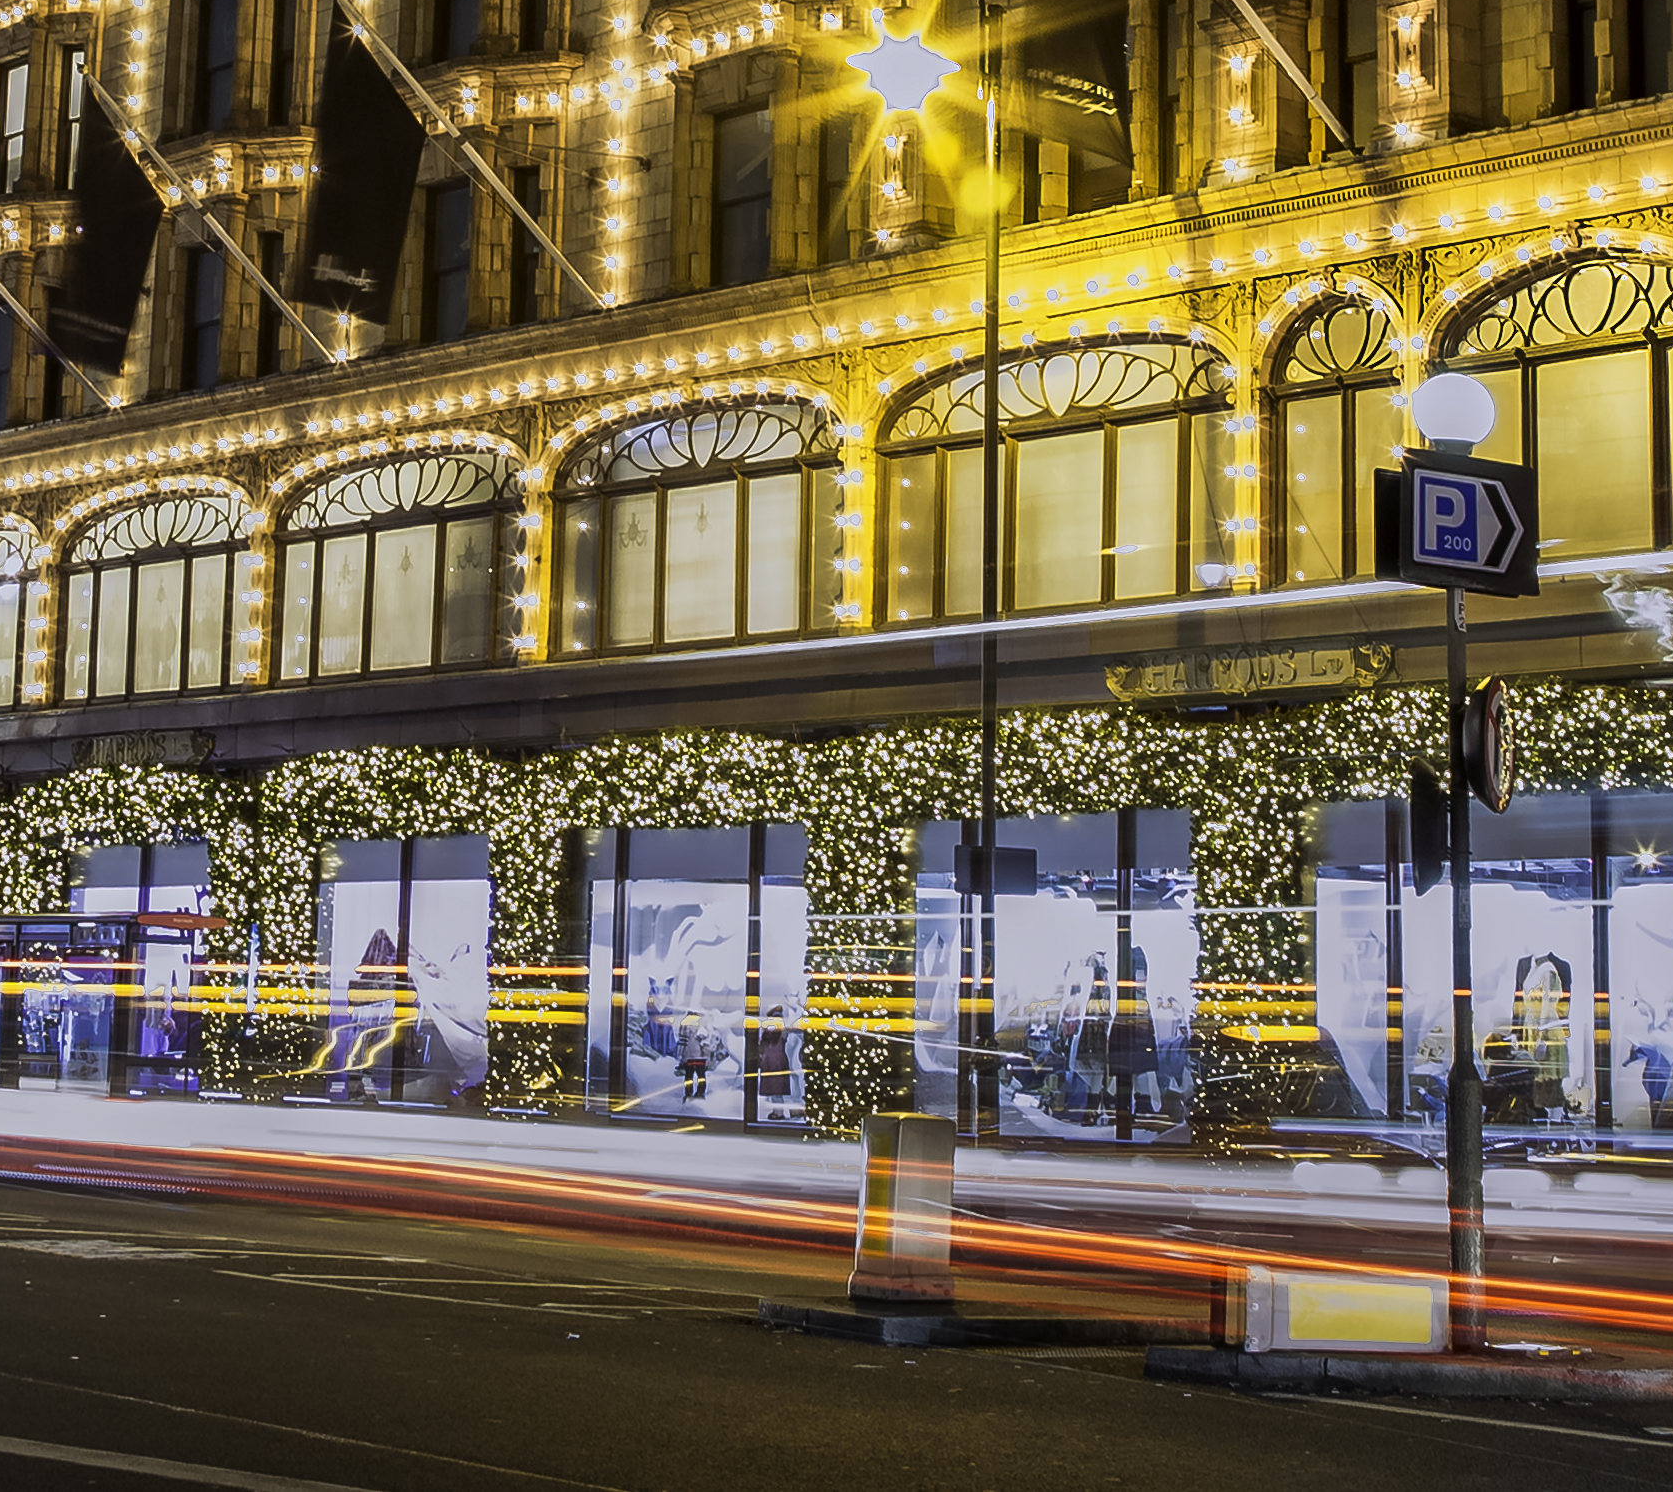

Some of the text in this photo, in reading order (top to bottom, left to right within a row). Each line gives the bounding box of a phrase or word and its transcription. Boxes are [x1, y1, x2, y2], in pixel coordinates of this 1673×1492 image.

[1424, 482, 1466, 551] P
[1443, 534, 1472, 552] 200
[1142, 645, 1298, 693] HARRODS
[90, 733, 167, 766] HARRODS
